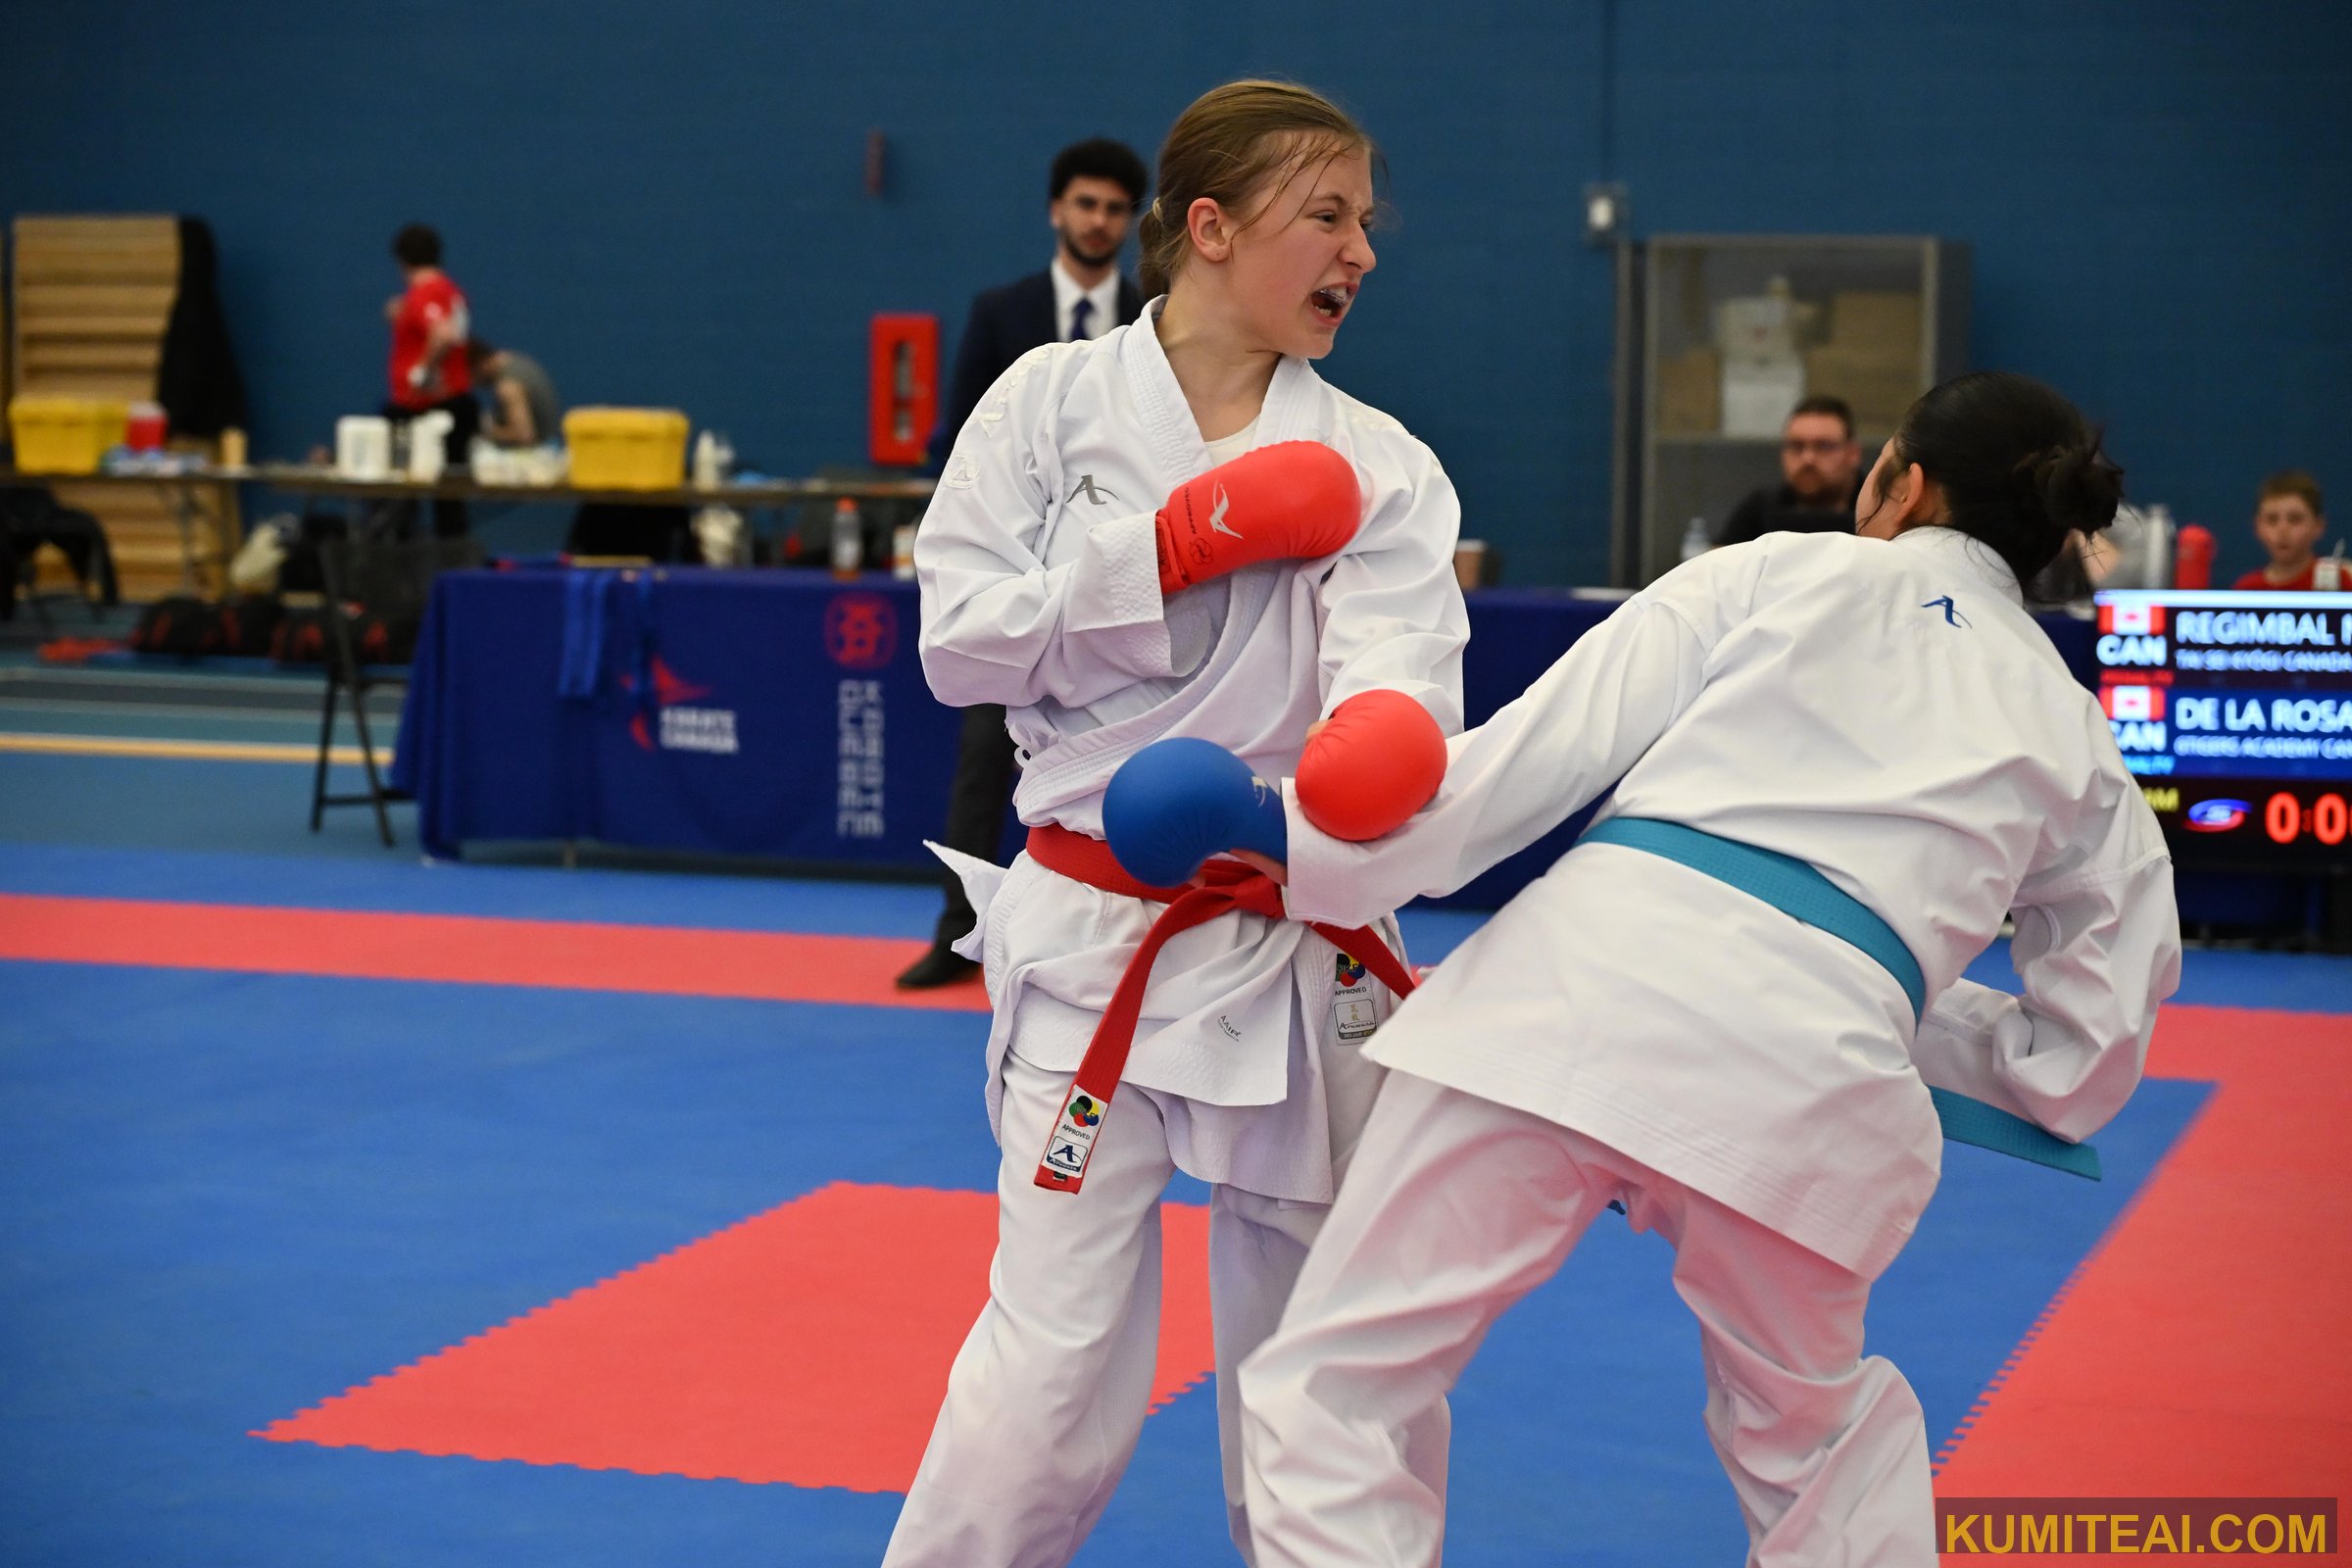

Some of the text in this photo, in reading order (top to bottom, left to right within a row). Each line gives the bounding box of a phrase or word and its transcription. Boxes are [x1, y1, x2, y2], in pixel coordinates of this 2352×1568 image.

[2176, 612, 2335, 645] REGIMBAL
[2097, 635, 2167, 665] CAN
[2175, 698, 2220, 730] DE
[2225, 699, 2267, 731] LA
[2265, 792, 2352, 845] 0:0
[1334, 986, 1367, 997] APPROVED
[1061, 1123, 1091, 1141] APPROVED
